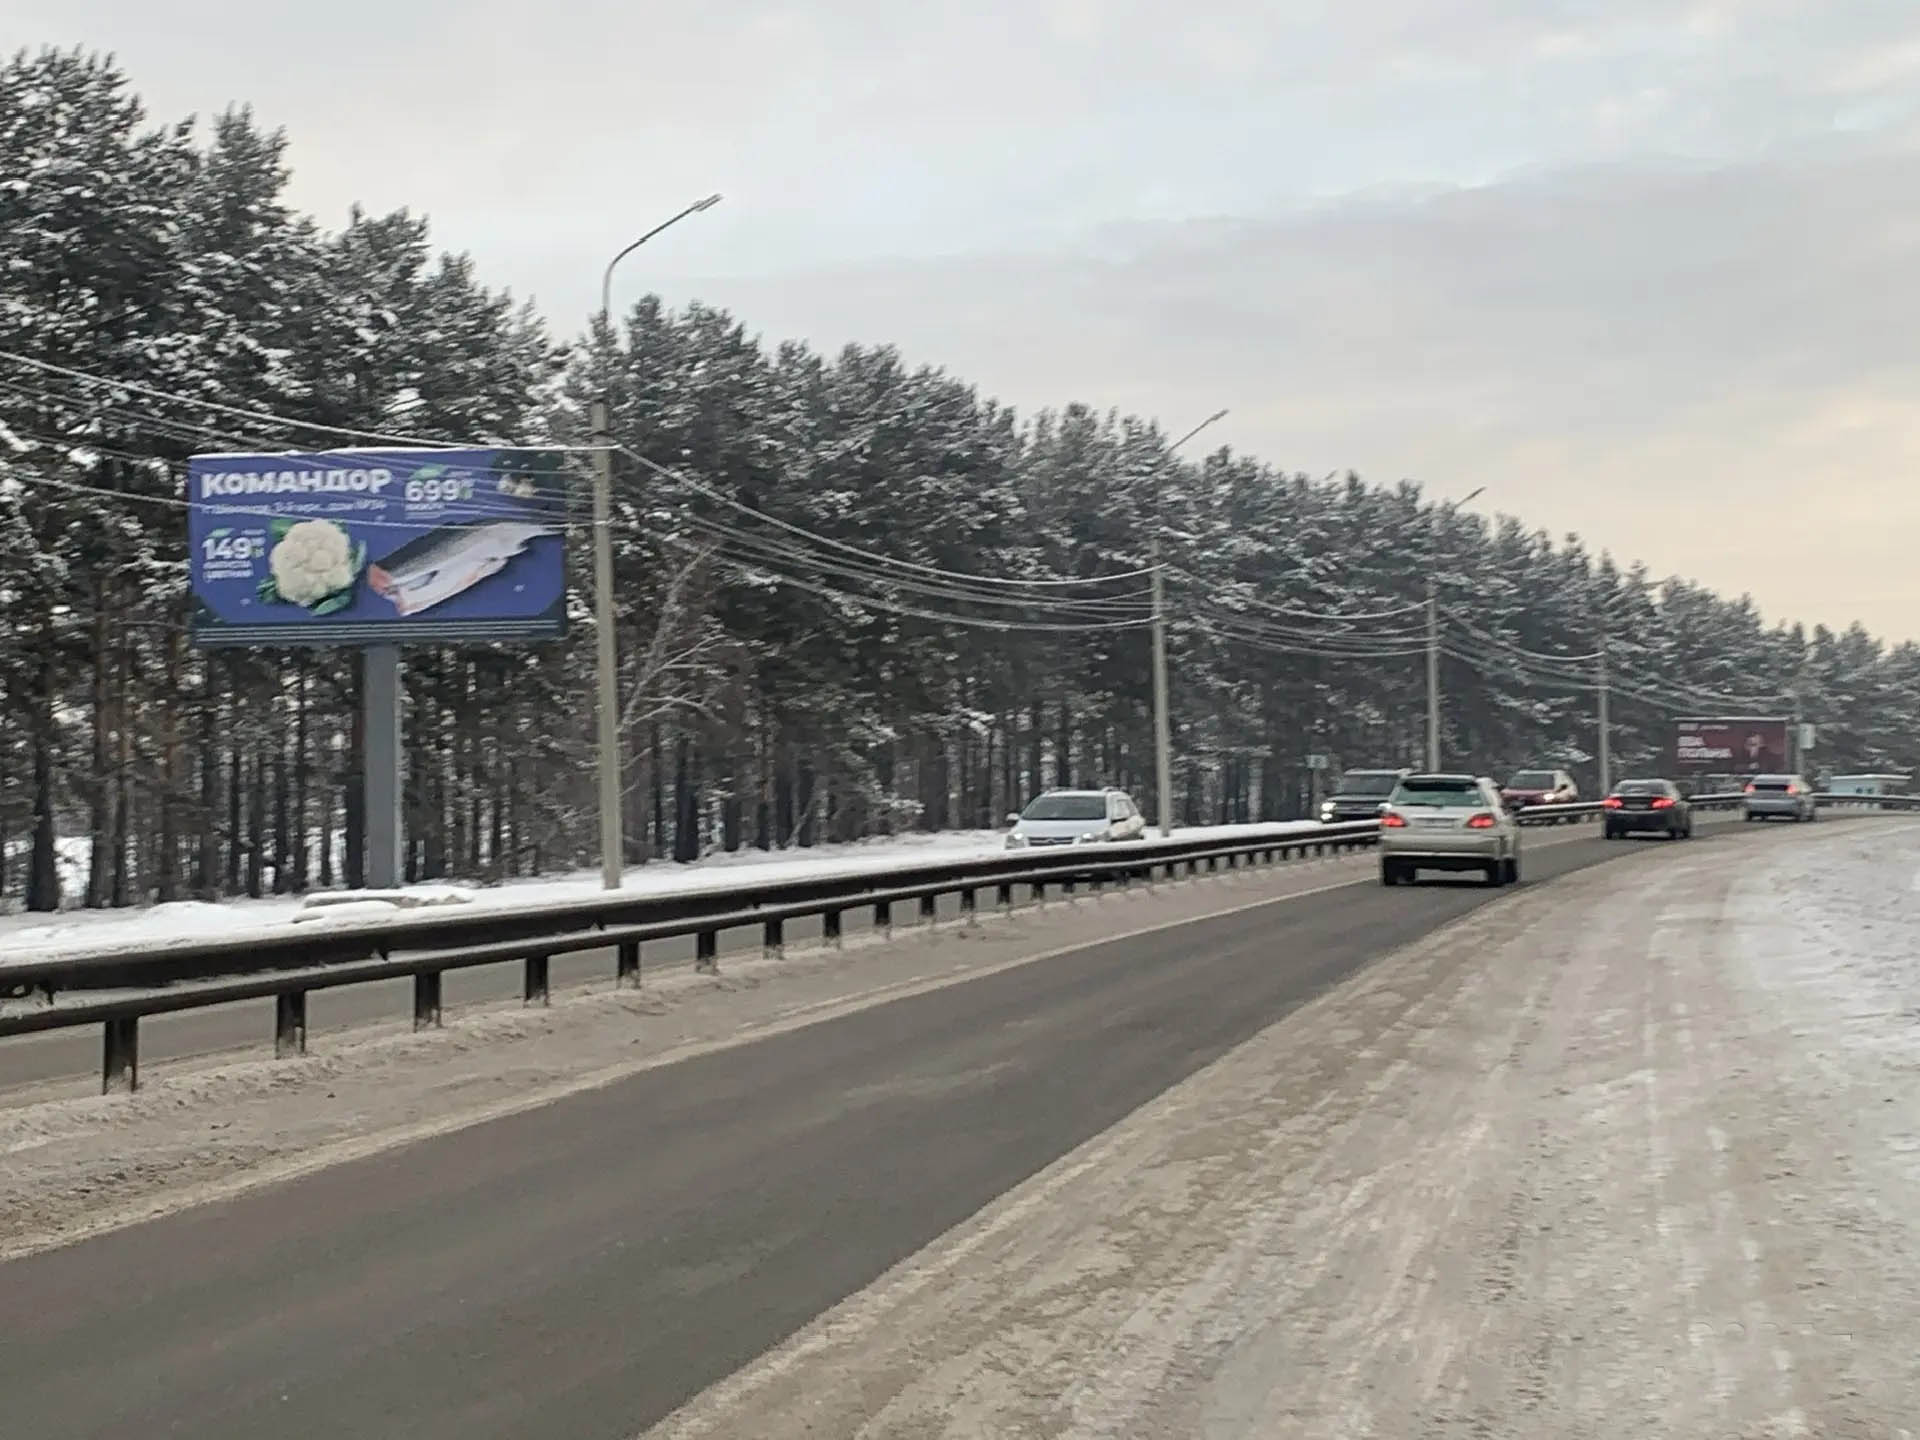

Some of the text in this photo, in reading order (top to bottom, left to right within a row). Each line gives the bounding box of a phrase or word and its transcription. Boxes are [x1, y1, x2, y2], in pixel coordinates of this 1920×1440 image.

[202, 469, 392, 498] КОМАНДОР
[405, 480, 458, 501] 699
[202, 537, 252, 560] 149
